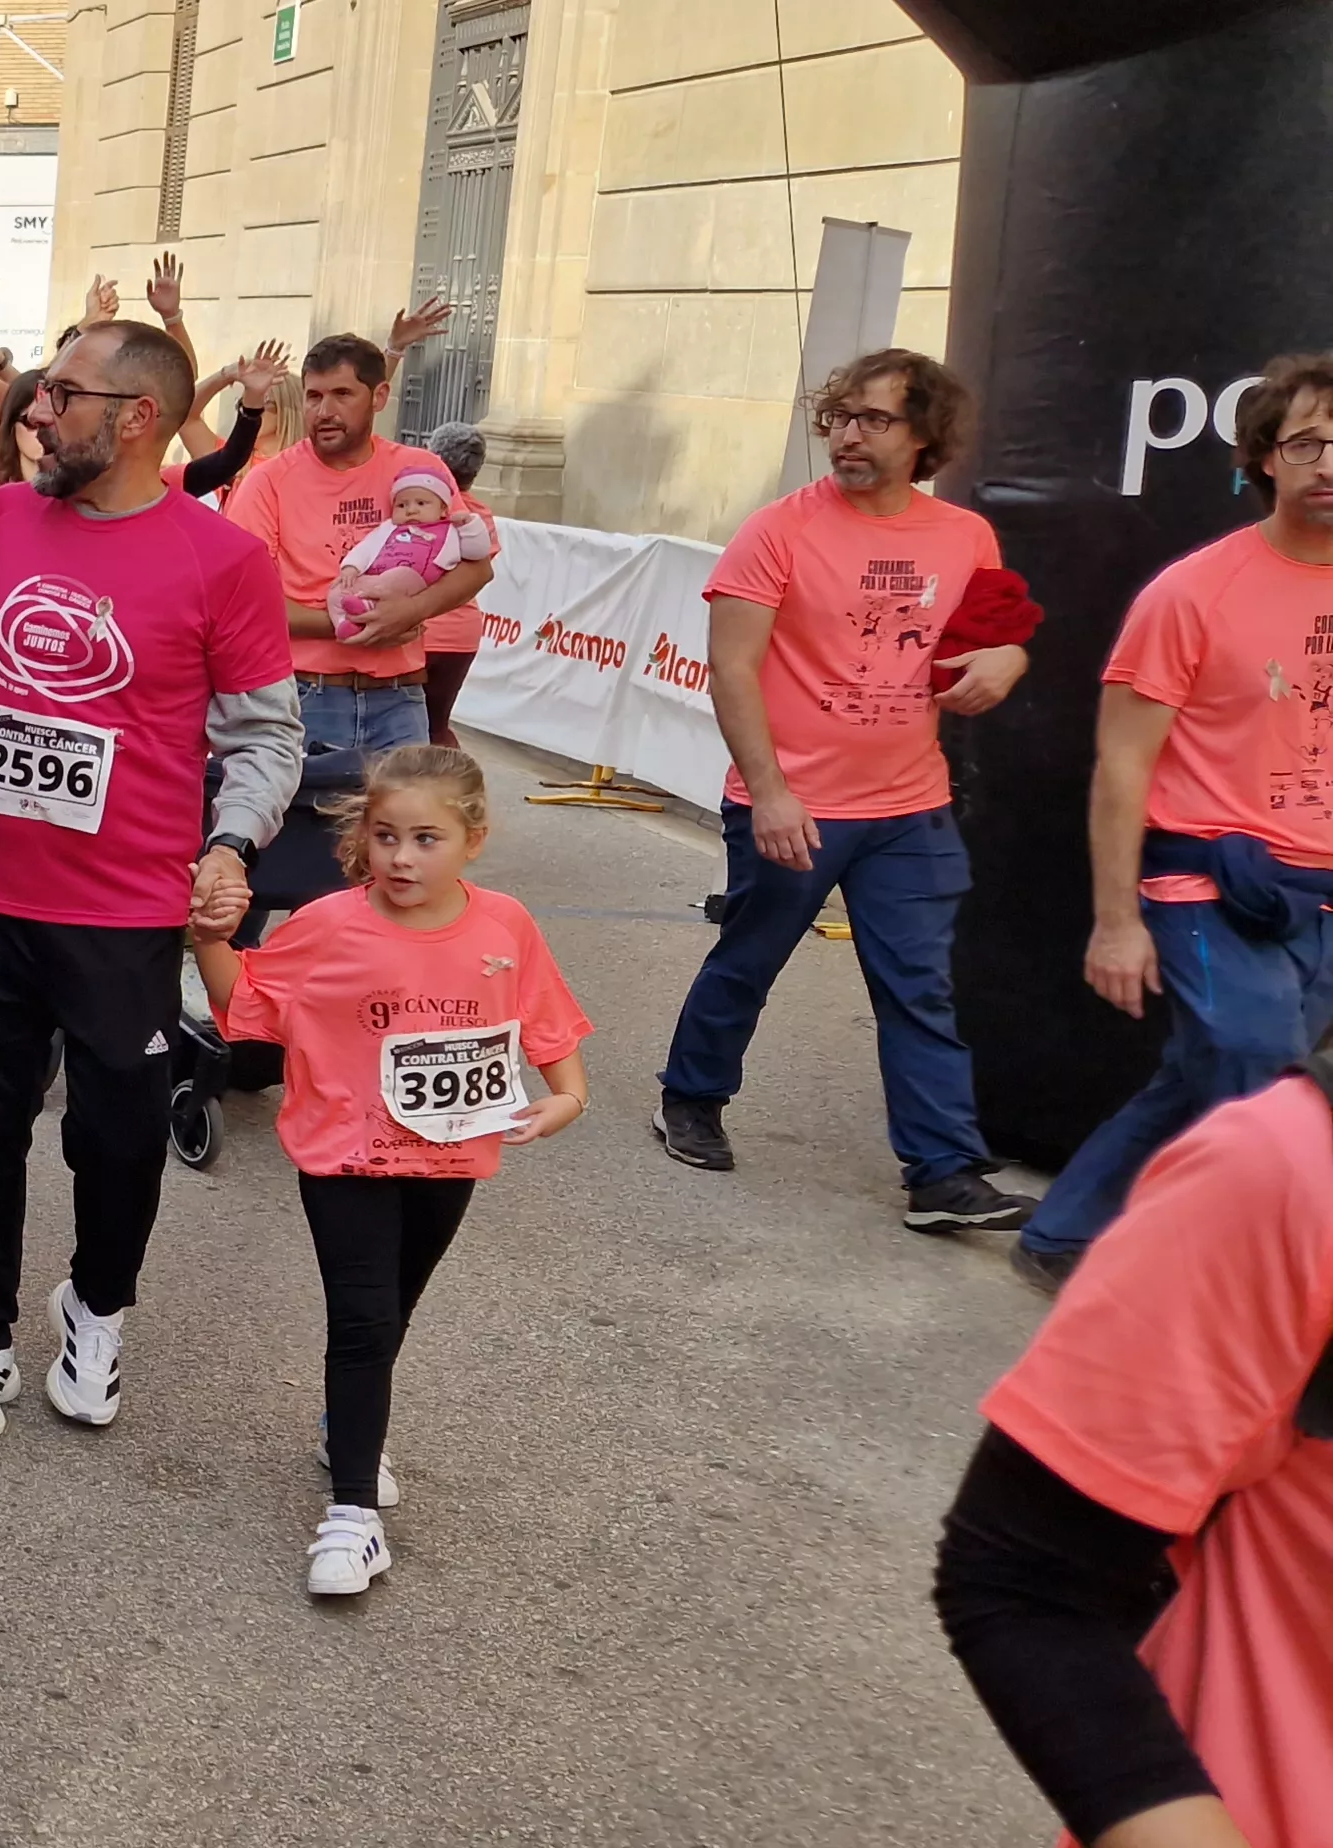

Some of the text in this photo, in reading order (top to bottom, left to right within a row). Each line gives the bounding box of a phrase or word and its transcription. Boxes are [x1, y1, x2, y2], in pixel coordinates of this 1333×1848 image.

[534, 612, 626, 673] Alcampo
[24, 724, 58, 738] HUESCA
[33, 736, 47, 748] EL
[48, 736, 99, 756] CÁNCER
[404, 994, 480, 1016] CÁNCER
[400, 1042, 507, 1066] CONTRA EL CÁNCER
[444, 1041, 480, 1052] HUESCA
[399, 1060, 508, 1112] 3988
